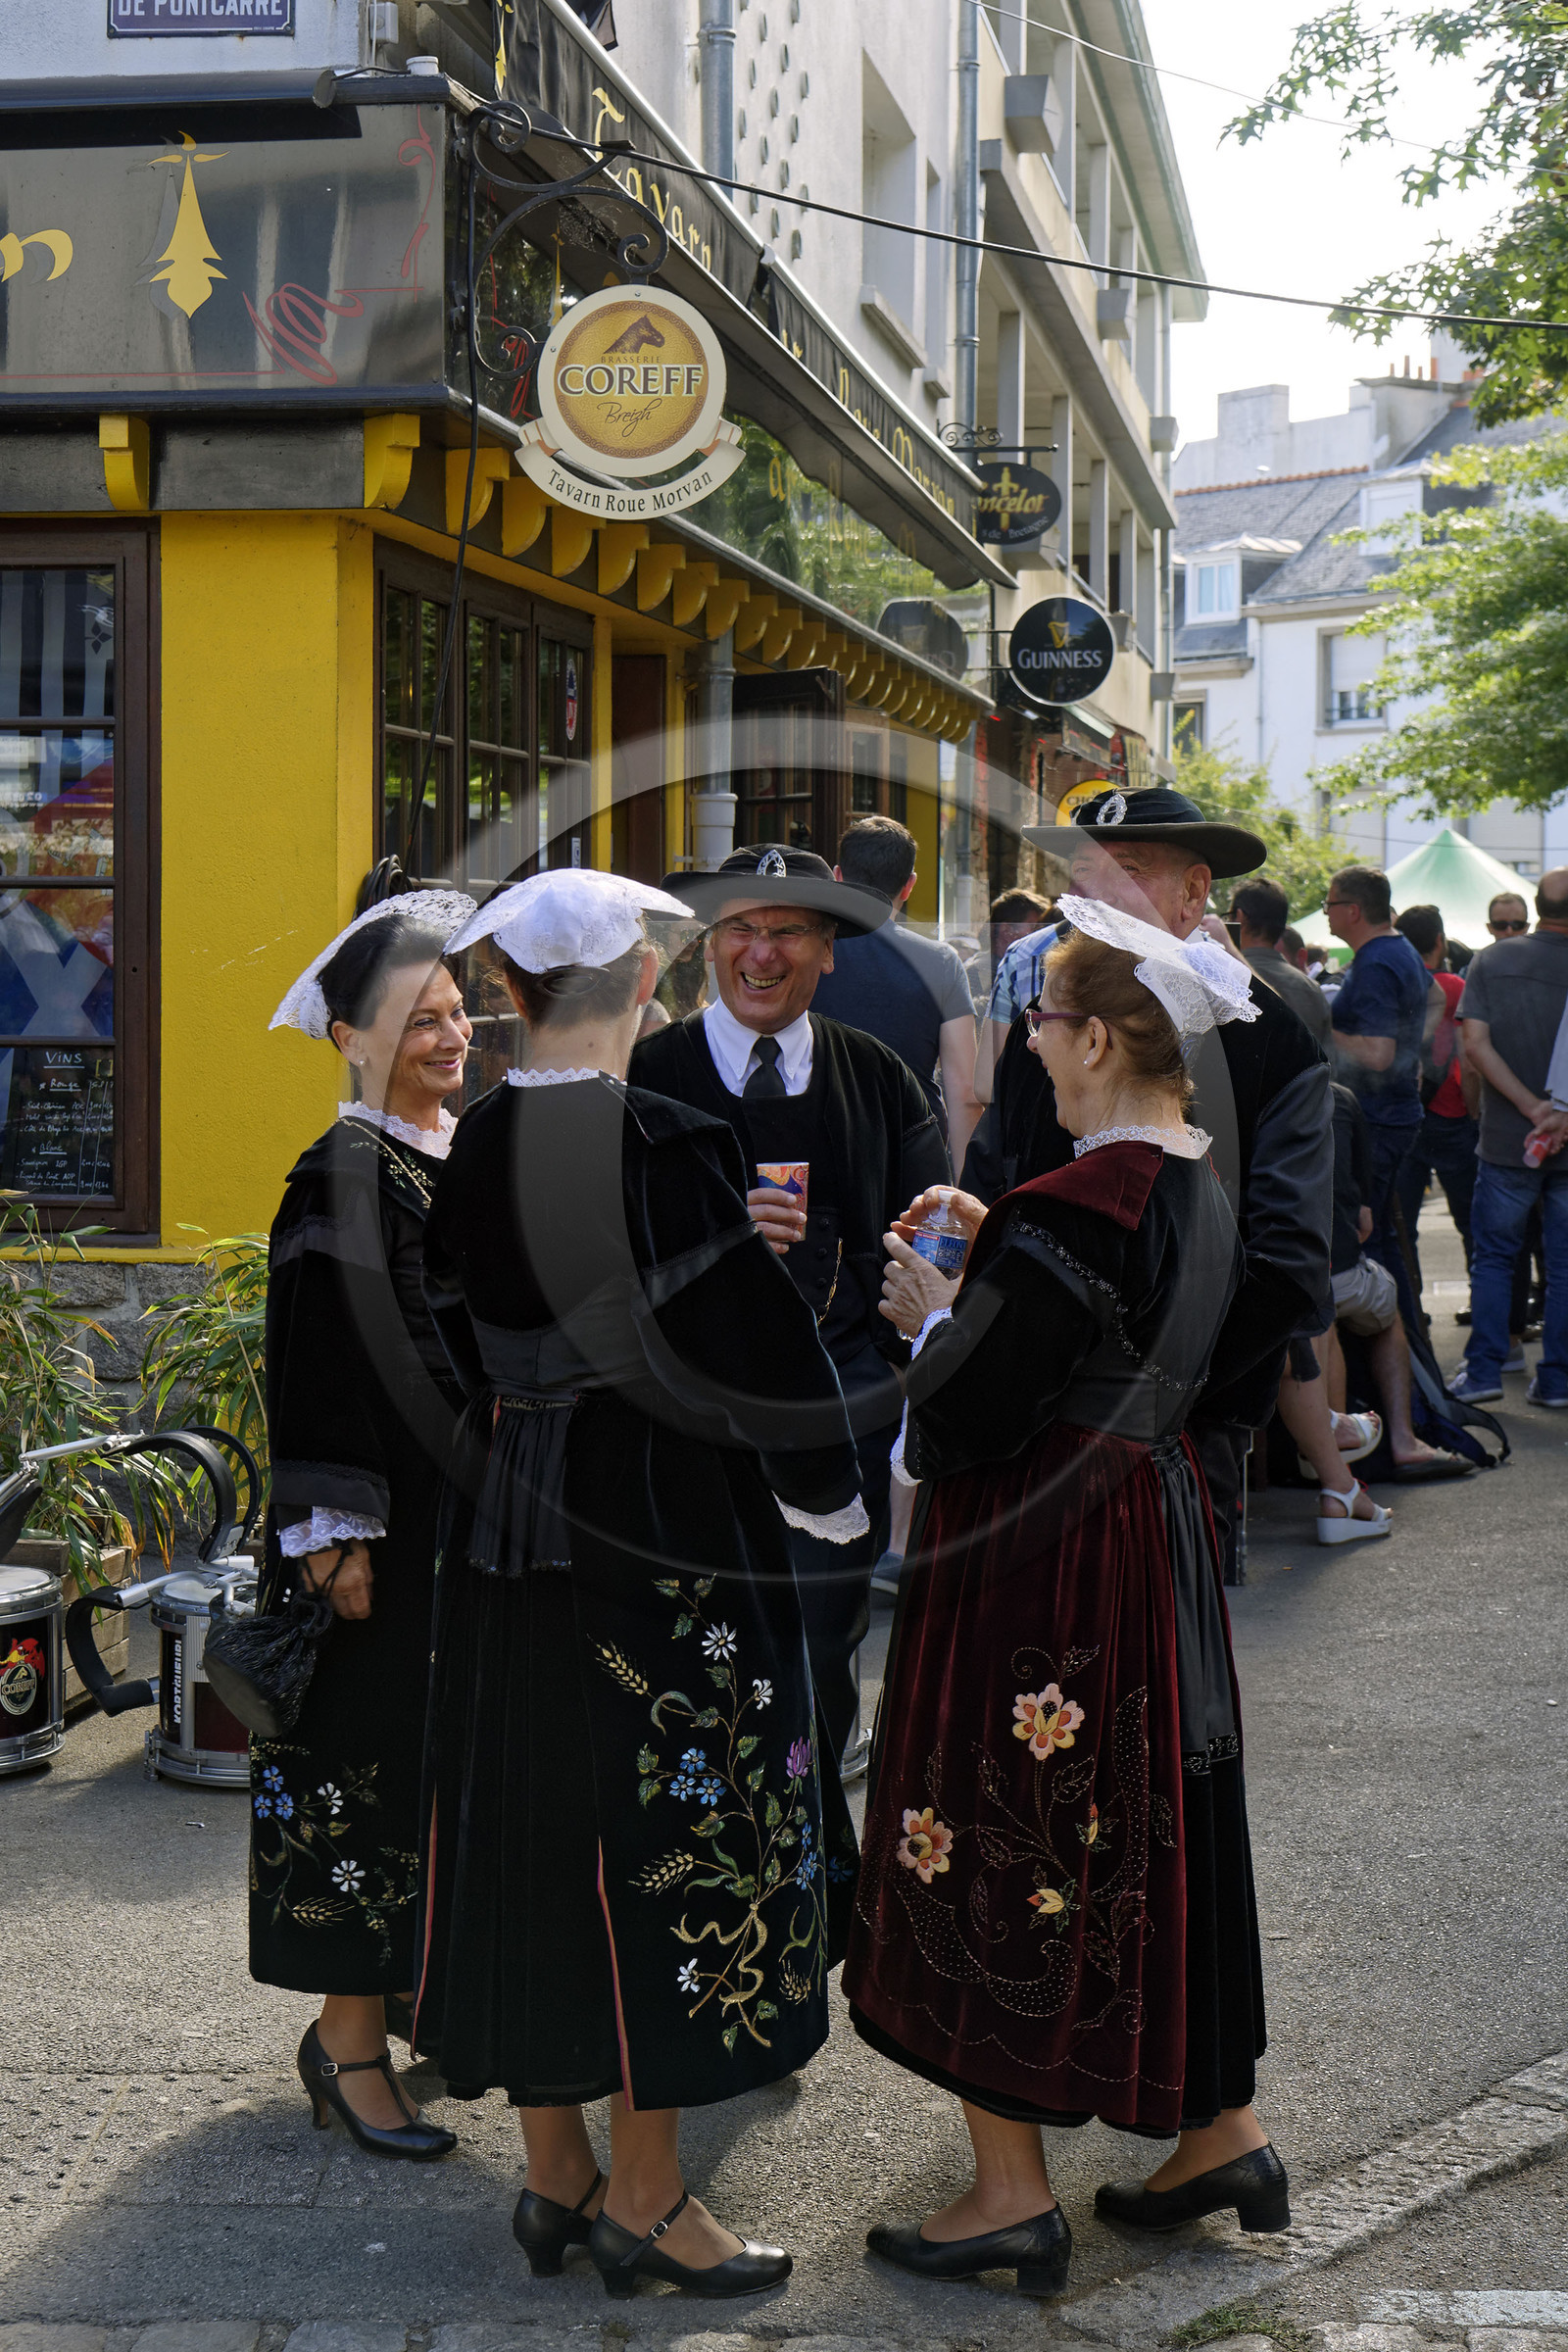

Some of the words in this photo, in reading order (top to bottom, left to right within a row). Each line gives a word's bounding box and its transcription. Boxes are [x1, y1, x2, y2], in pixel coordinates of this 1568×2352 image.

[118, 0, 145, 16] DE
[557, 364, 704, 397] COREFF
[596, 398, 662, 438] Breizh
[547, 468, 601, 509] Tavarn
[605, 493, 646, 513] Roue
[652, 470, 712, 512] Morvan
[1017, 648, 1103, 669] GUINNESS
